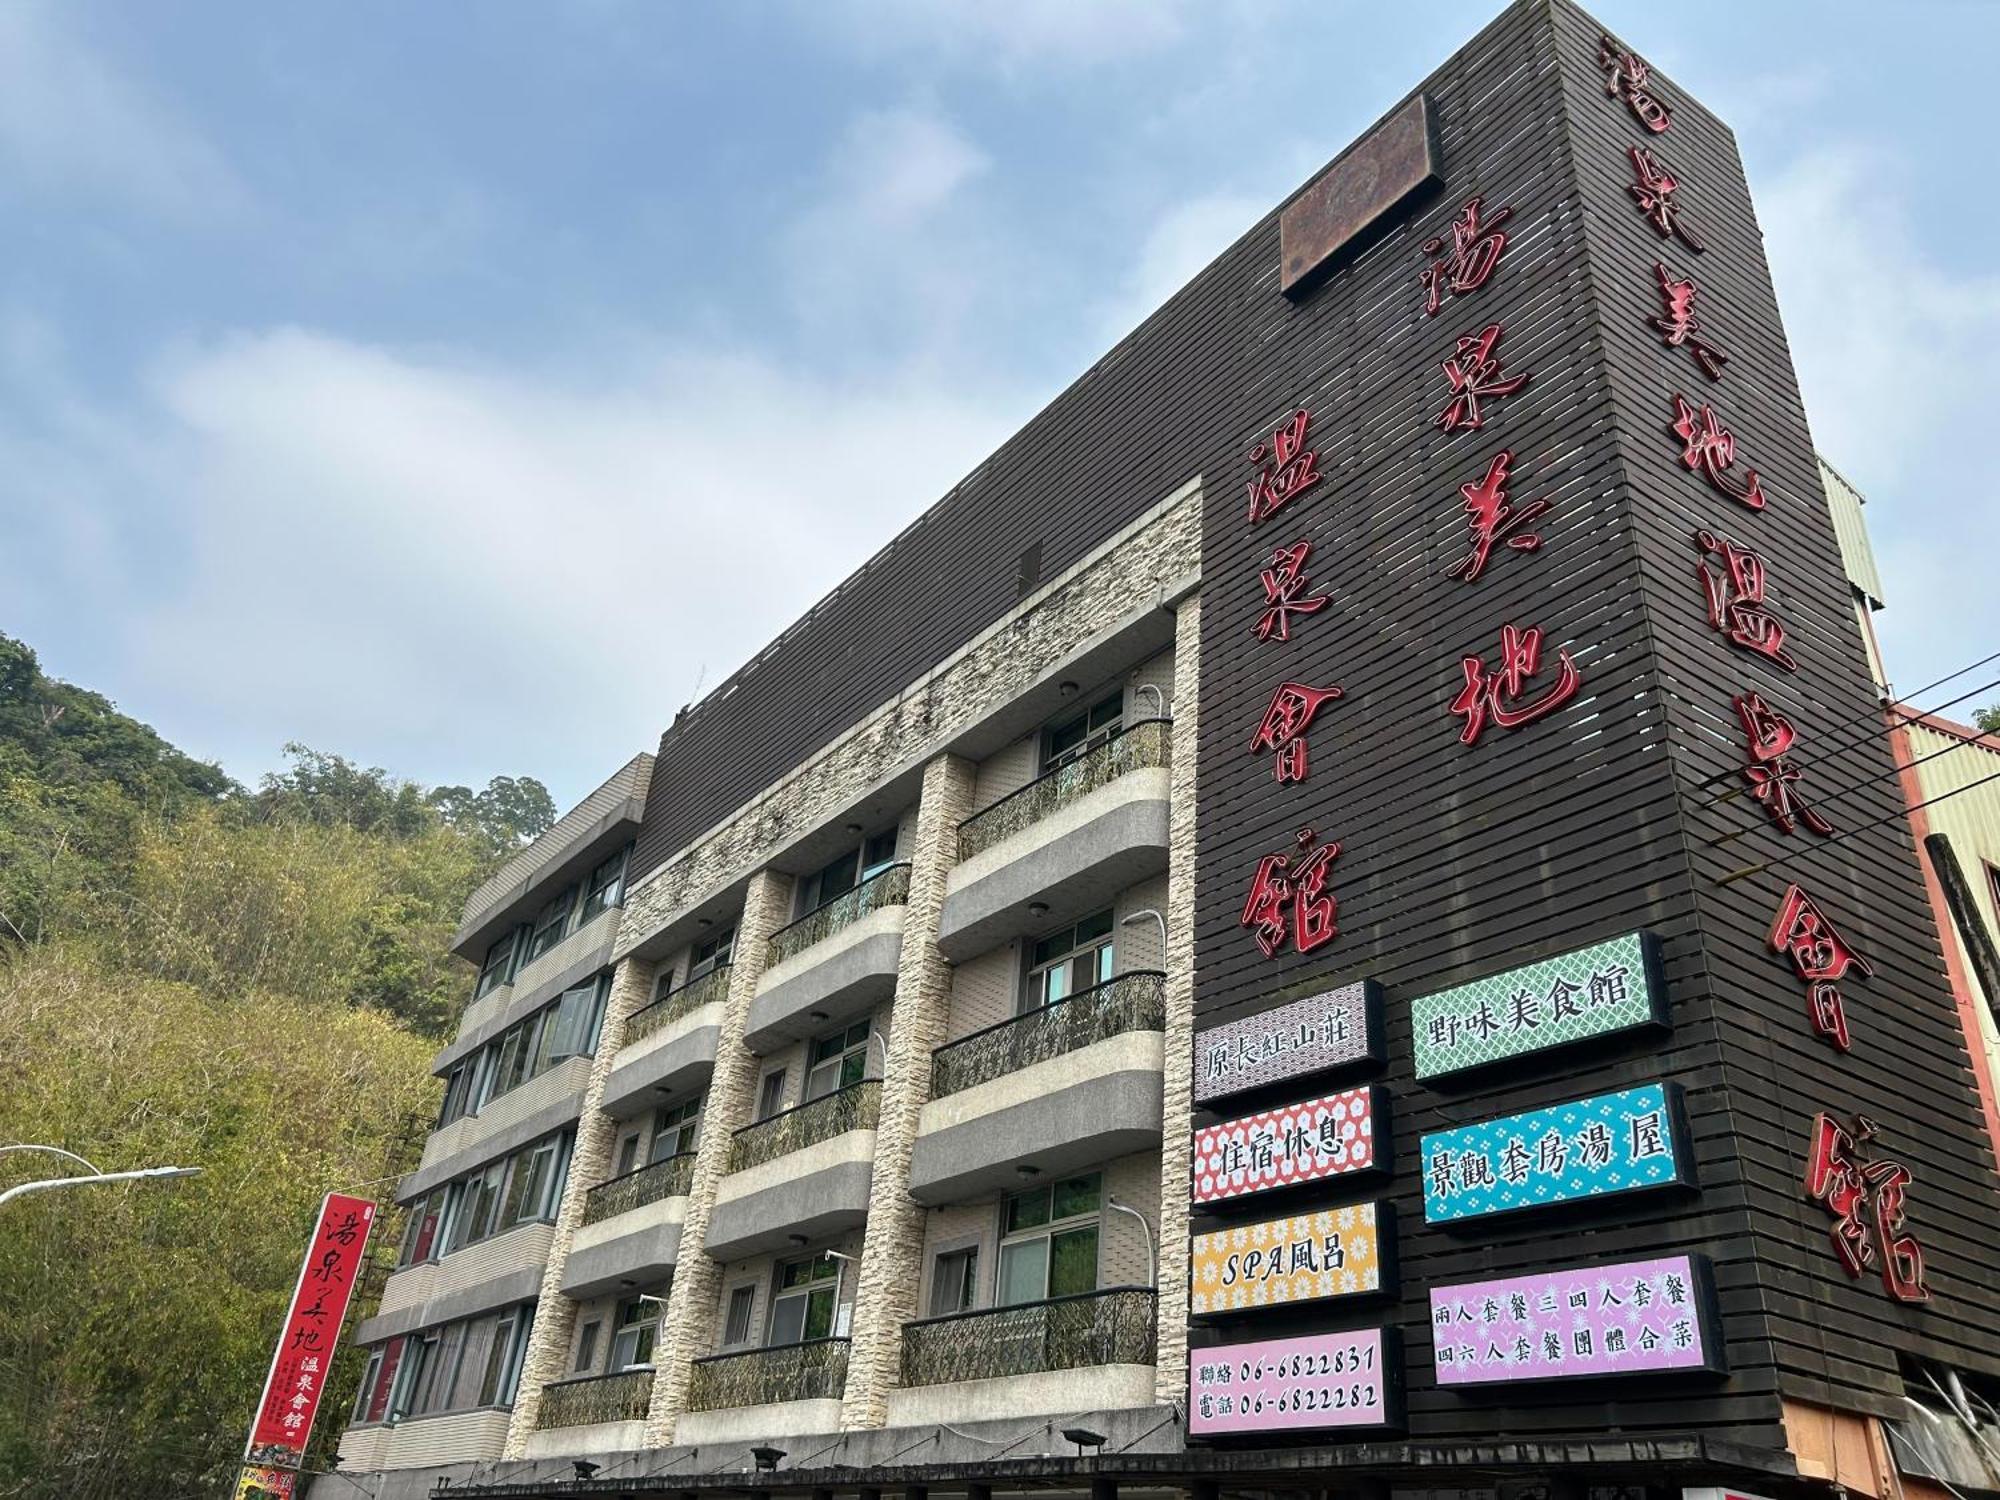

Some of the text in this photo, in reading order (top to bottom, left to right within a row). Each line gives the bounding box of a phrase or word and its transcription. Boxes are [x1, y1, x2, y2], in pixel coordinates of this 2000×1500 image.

[1428, 964, 1630, 1048] 野味美食館
[1206, 1007, 1351, 1079] 原長紅山莊
[1219, 1115, 1344, 1177] 住宿休息
[1428, 1112, 1667, 1198] 景觀套房湯屋
[1221, 1232, 1346, 1286] SPA風呂
[1198, 1344, 1375, 1386] 聯絡 06-6822831
[1198, 1384, 1378, 1419] 電話 06-6822282
